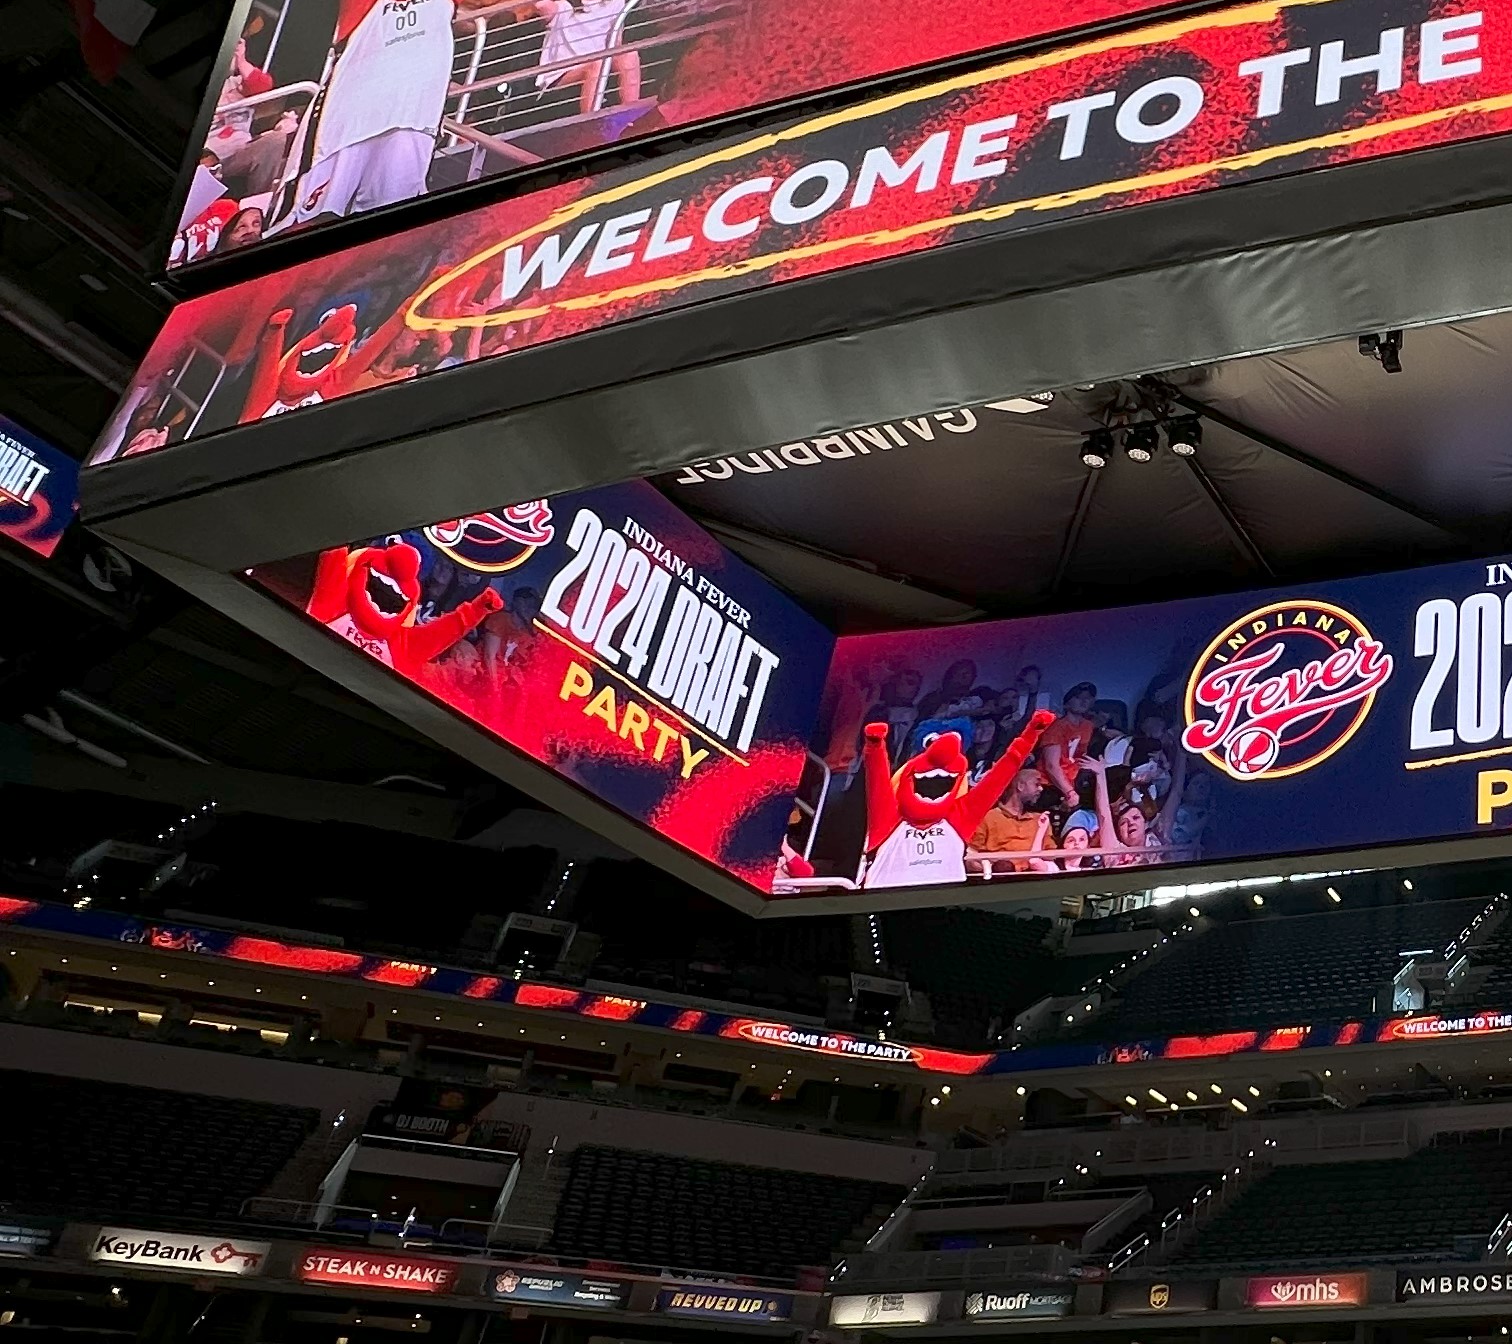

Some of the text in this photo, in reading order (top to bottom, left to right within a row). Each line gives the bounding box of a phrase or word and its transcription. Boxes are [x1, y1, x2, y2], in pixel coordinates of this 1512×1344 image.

[500, 115, 1017, 302] WELCOME
[1046, 74, 1206, 162] TO
[1238, 9, 1489, 120] THE
[622, 516, 695, 587] INDIANA
[696, 574, 752, 629] FEVER
[540, 508, 781, 754] 2024 DRAFT
[1214, 610, 1352, 663] INDIANA
[1181, 635, 1395, 756] Fever
[559, 661, 710, 780] PARTY
[1403, 1018, 1466, 1034] WELCOME
[1467, 1016, 1486, 1029] TO
[1487, 1013, 1512, 1027] THE
[751, 1025, 912, 1061] WELCOME TO THE PARTY
[96, 1235, 205, 1265] KeyBank
[303, 1256, 448, 1285] STEAK N SHAKE
[670, 1293, 764, 1313] REVVED UP
[985, 1293, 1030, 1311] Ruoff
[1296, 1277, 1340, 1301] mhs
